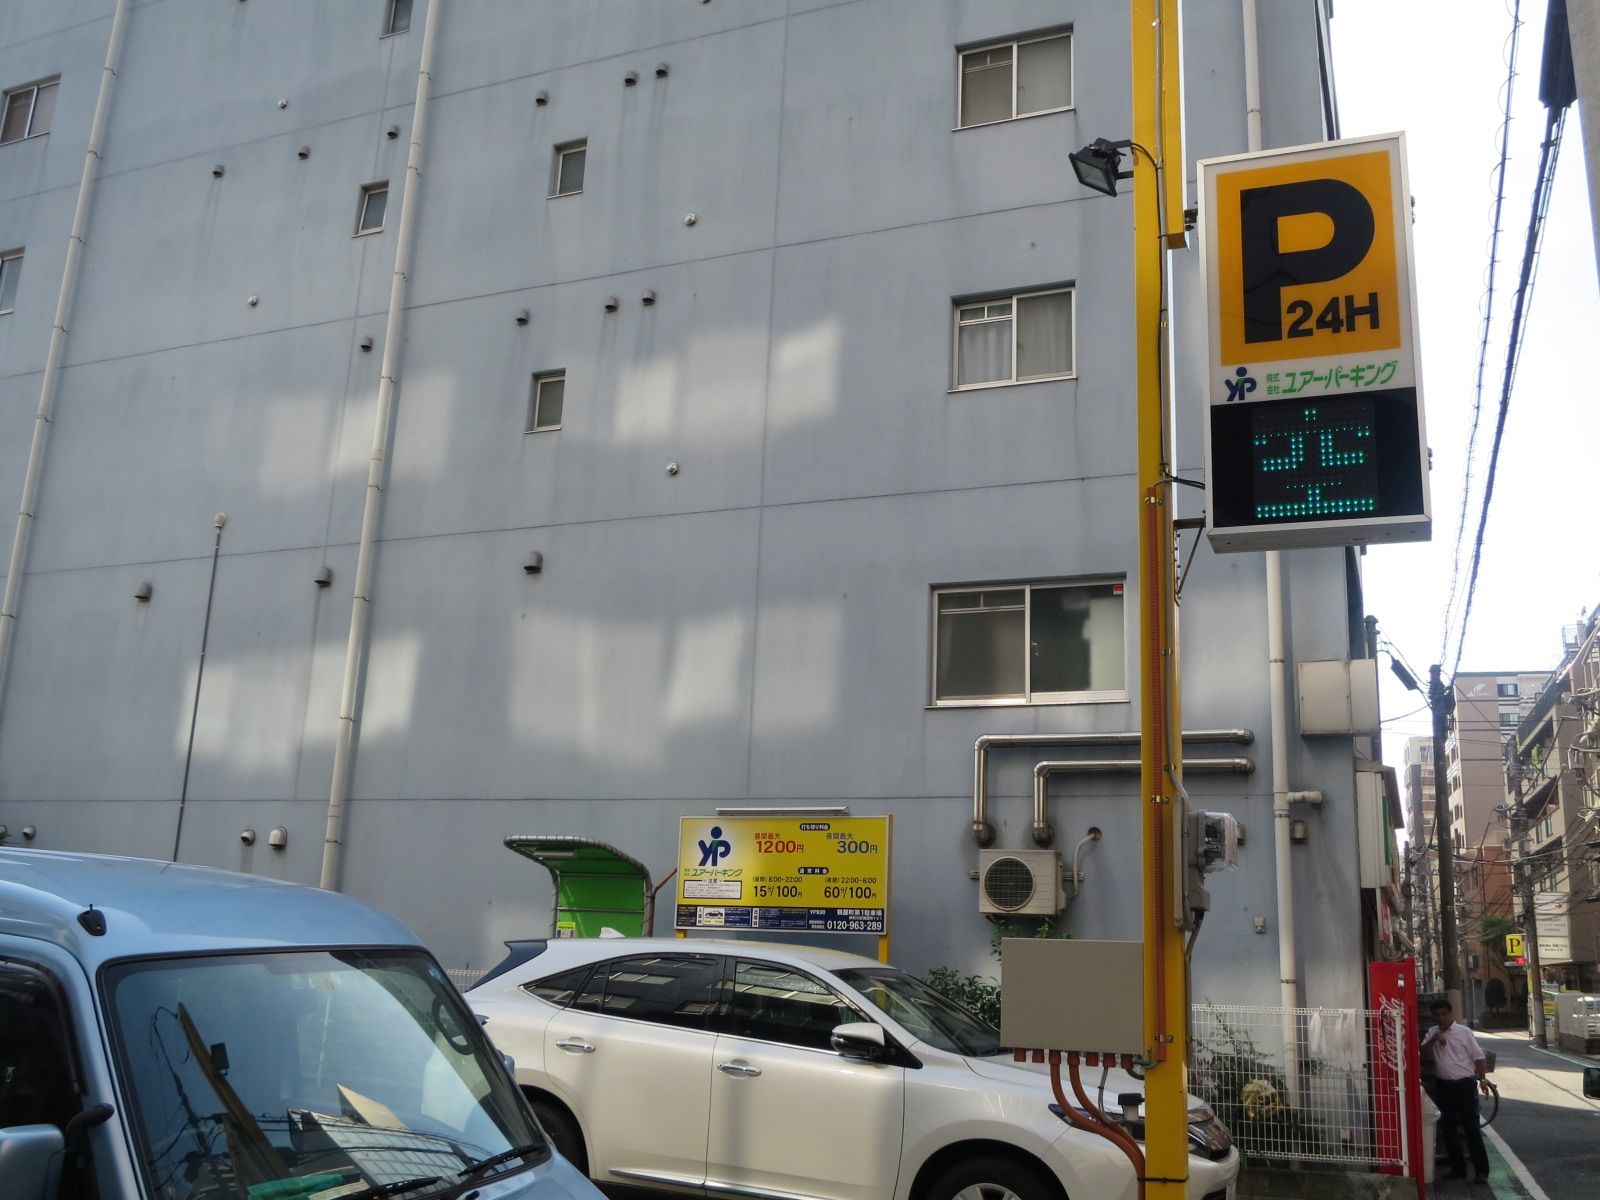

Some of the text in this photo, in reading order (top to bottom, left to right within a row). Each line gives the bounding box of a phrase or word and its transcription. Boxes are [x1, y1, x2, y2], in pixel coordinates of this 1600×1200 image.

[1239, 177, 1376, 345] P
[1286, 291, 1380, 340] 24H
[1254, 408, 1375, 519] 空
[756, 840, 804, 854] 1200円
[837, 840, 878, 854] 300円
[826, 920, 882, 930] 0120-963-289
[1509, 937, 1521, 953] P
